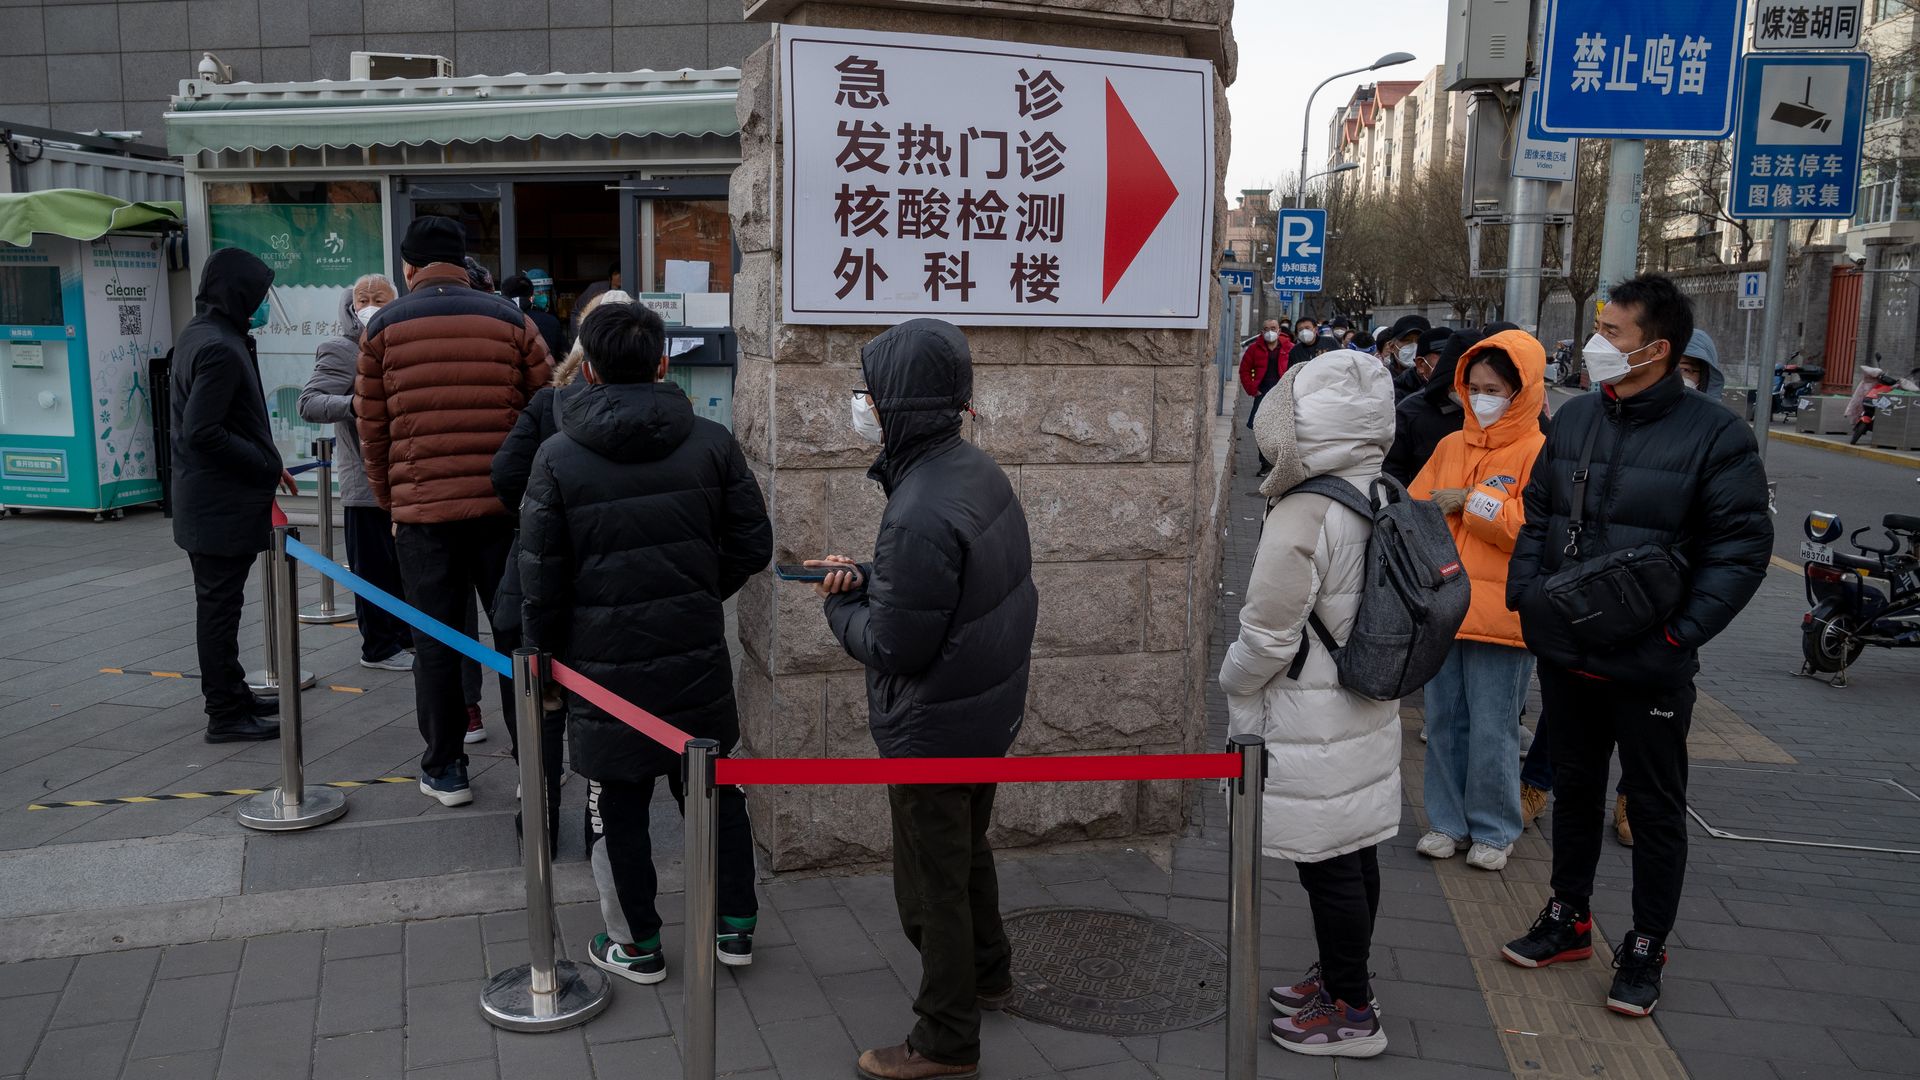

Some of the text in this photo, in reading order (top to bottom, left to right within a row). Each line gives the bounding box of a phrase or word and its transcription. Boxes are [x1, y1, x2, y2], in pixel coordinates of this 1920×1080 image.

[1761, 4, 1857, 41] 煤渣胡同
[1571, 32, 1712, 95] 禁止鸣笛
[835, 120, 1067, 182] 发热门诊
[1524, 148, 1567, 163] 图像采集区域
[1536, 161, 1553, 170] Video
[1750, 154, 1843, 178] 违法停车
[1748, 184, 1841, 208] 图像采集
[834, 183, 1065, 243] 核酸检测
[1281, 216, 1314, 257] P
[833, 247, 1060, 303] 外科楼
[1281, 263, 1317, 273] 协和医院
[1276, 275, 1320, 286] 地下停车场
[105, 284, 147, 297] Cleaner
[647, 301, 677, 310] 室内限流
[1485, 501, 1494, 513] 27
[1801, 549, 1830, 563] H83704
[1650, 707, 1674, 719] Jeep
